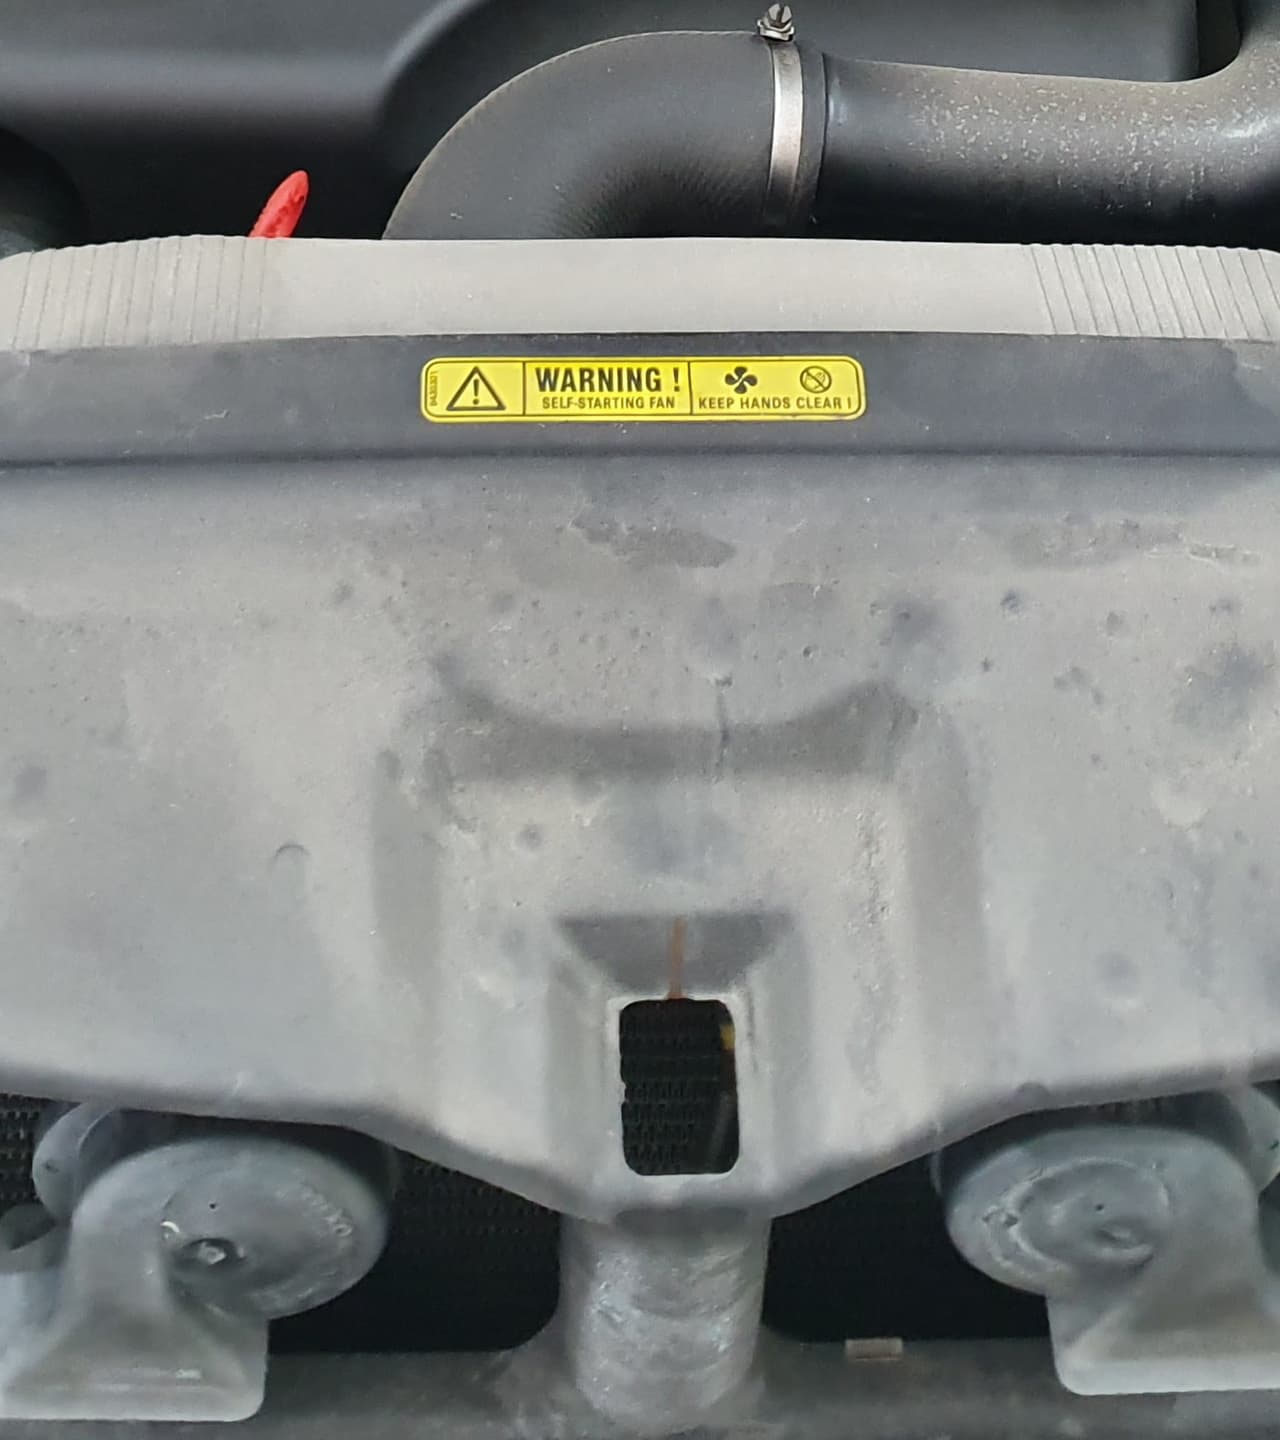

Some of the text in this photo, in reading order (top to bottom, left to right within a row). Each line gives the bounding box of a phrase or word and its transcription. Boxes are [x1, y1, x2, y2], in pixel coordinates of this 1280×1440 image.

[535, 367, 682, 392] WARNING !
[541, 396, 676, 409] SELF-STARTING FAN
[698, 397, 735, 410] KEEP
[740, 397, 791, 410] HANDS
[796, 397, 842, 410] CLEAR
